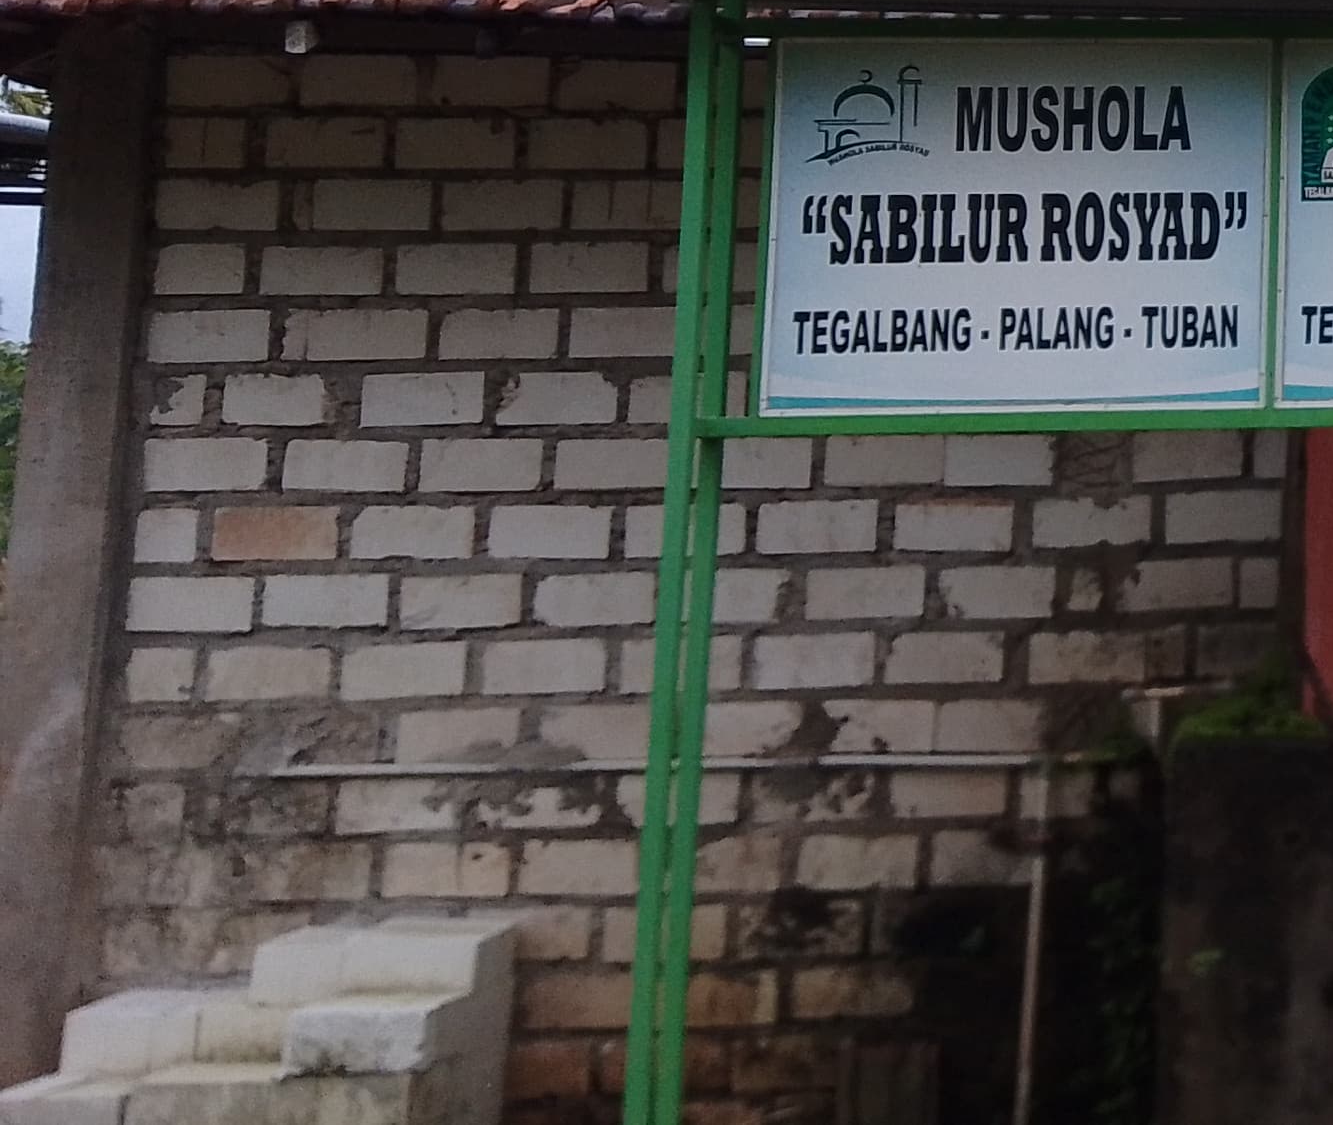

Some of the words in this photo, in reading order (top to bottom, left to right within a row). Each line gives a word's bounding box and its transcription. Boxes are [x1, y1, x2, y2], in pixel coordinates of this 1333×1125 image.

[955, 85, 1192, 152] MUSHOLA
[793, 309, 972, 356] TEGALBANG
[999, 307, 1115, 351] PALANG
[1141, 305, 1239, 350] TUBAN
